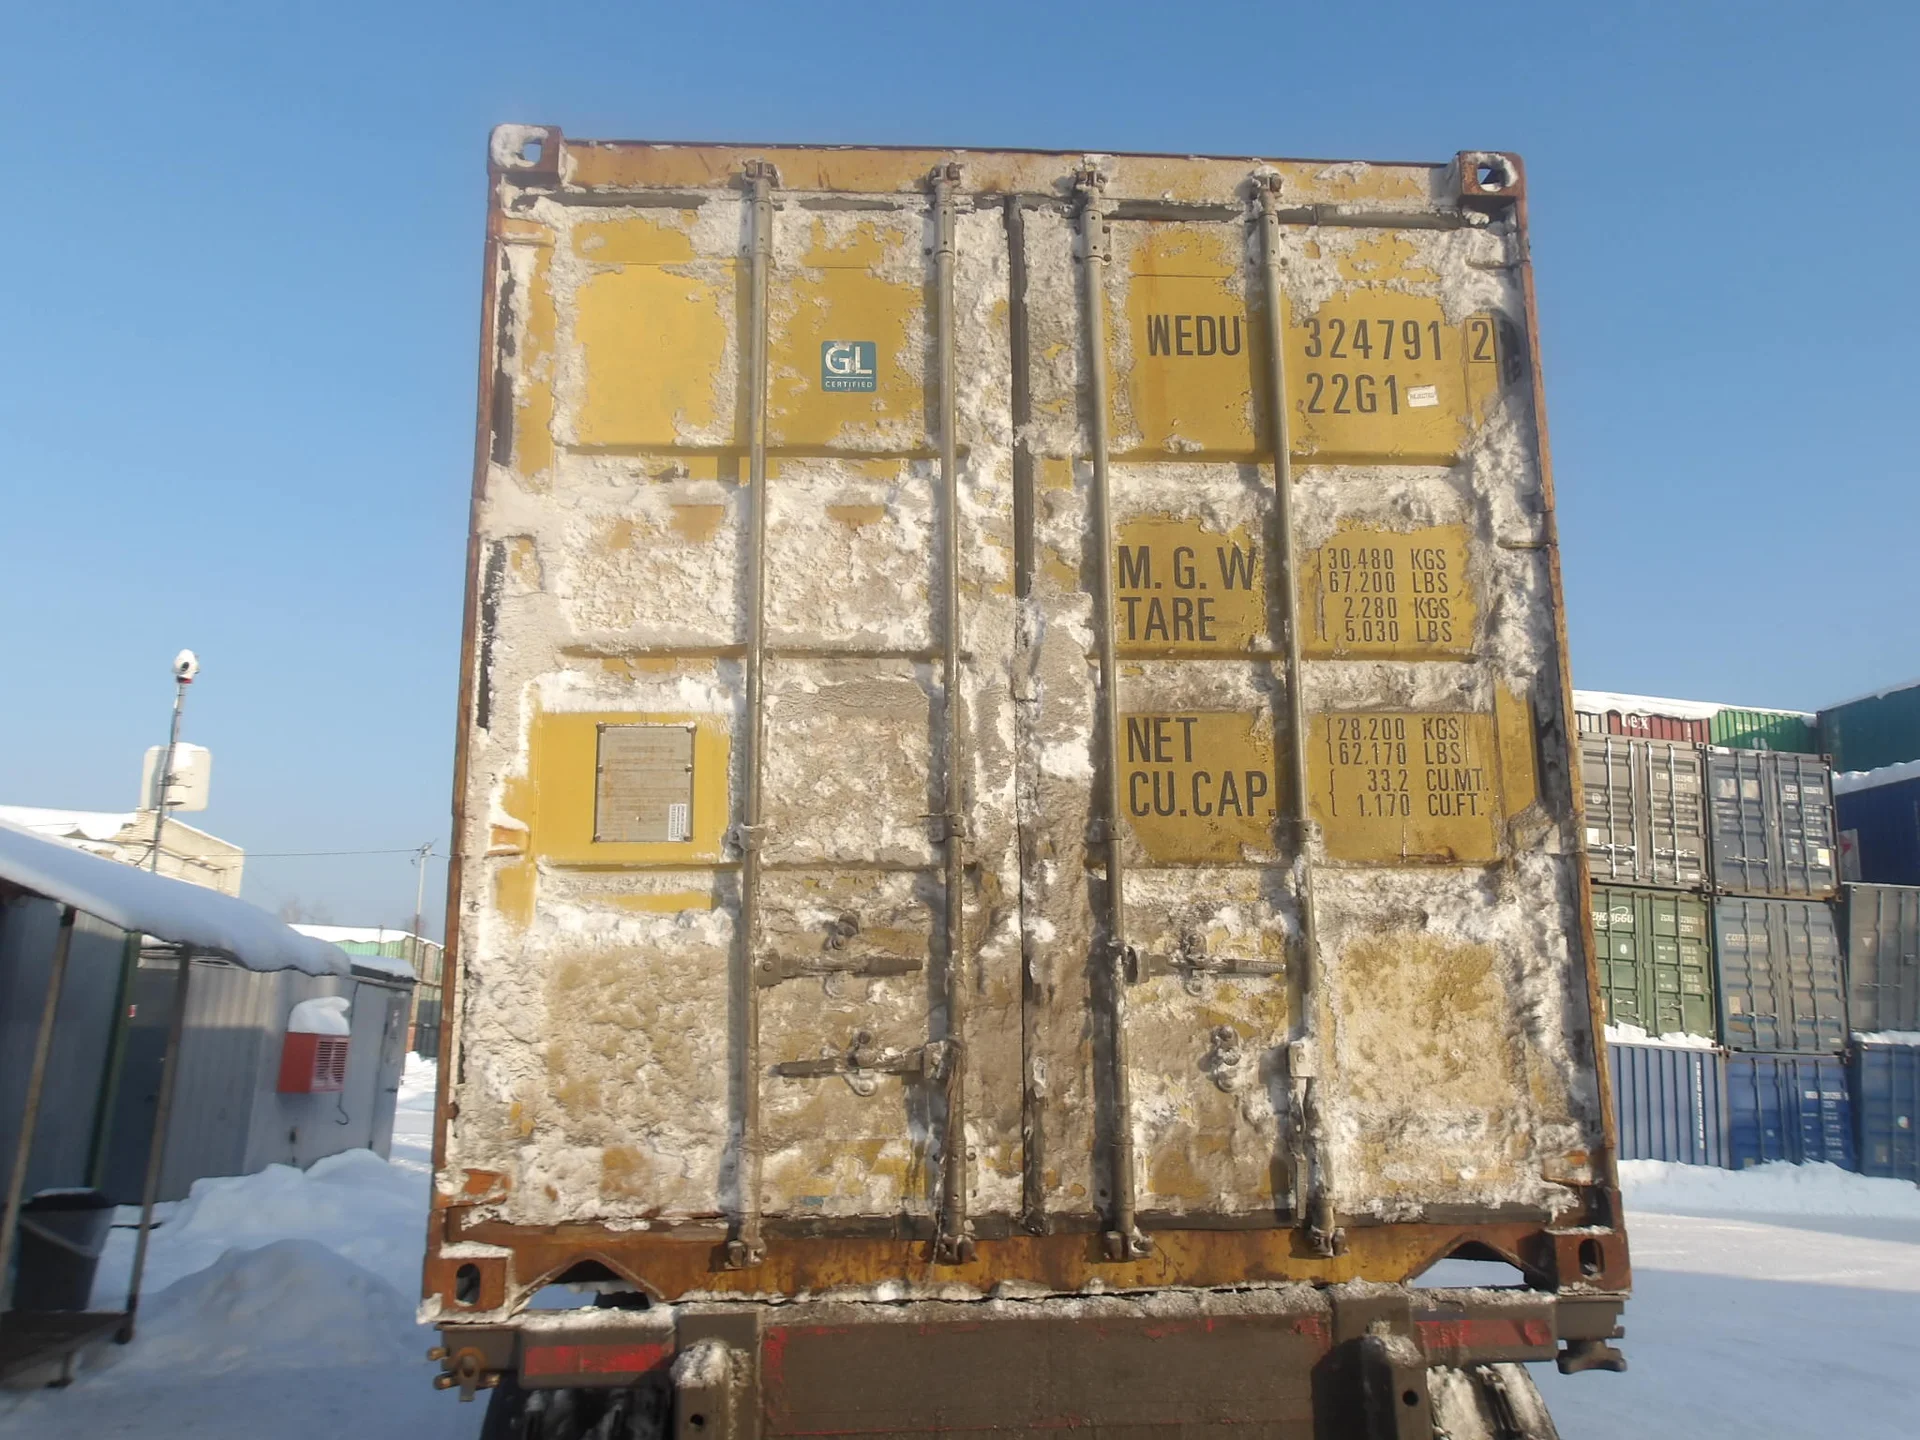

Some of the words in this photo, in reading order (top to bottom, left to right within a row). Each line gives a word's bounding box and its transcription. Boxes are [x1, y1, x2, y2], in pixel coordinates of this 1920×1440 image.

[1147, 314, 1242, 356] WEDU
[1303, 317, 1442, 361] 324791
[1472, 321, 1490, 361] 2
[825, 346, 873, 374] GL
[1306, 373, 1399, 415] 22G1
[1410, 548, 1446, 570] KGS
[1413, 572, 1448, 593] LBS
[1120, 597, 1217, 641] TARE
[1414, 597, 1450, 619] KGS
[1416, 620, 1452, 642] LBS
[1127, 717, 1198, 762] NET
[1422, 718, 1459, 741] KGS
[1424, 742, 1461, 765] LBS
[1367, 769, 1409, 792] 33.2
